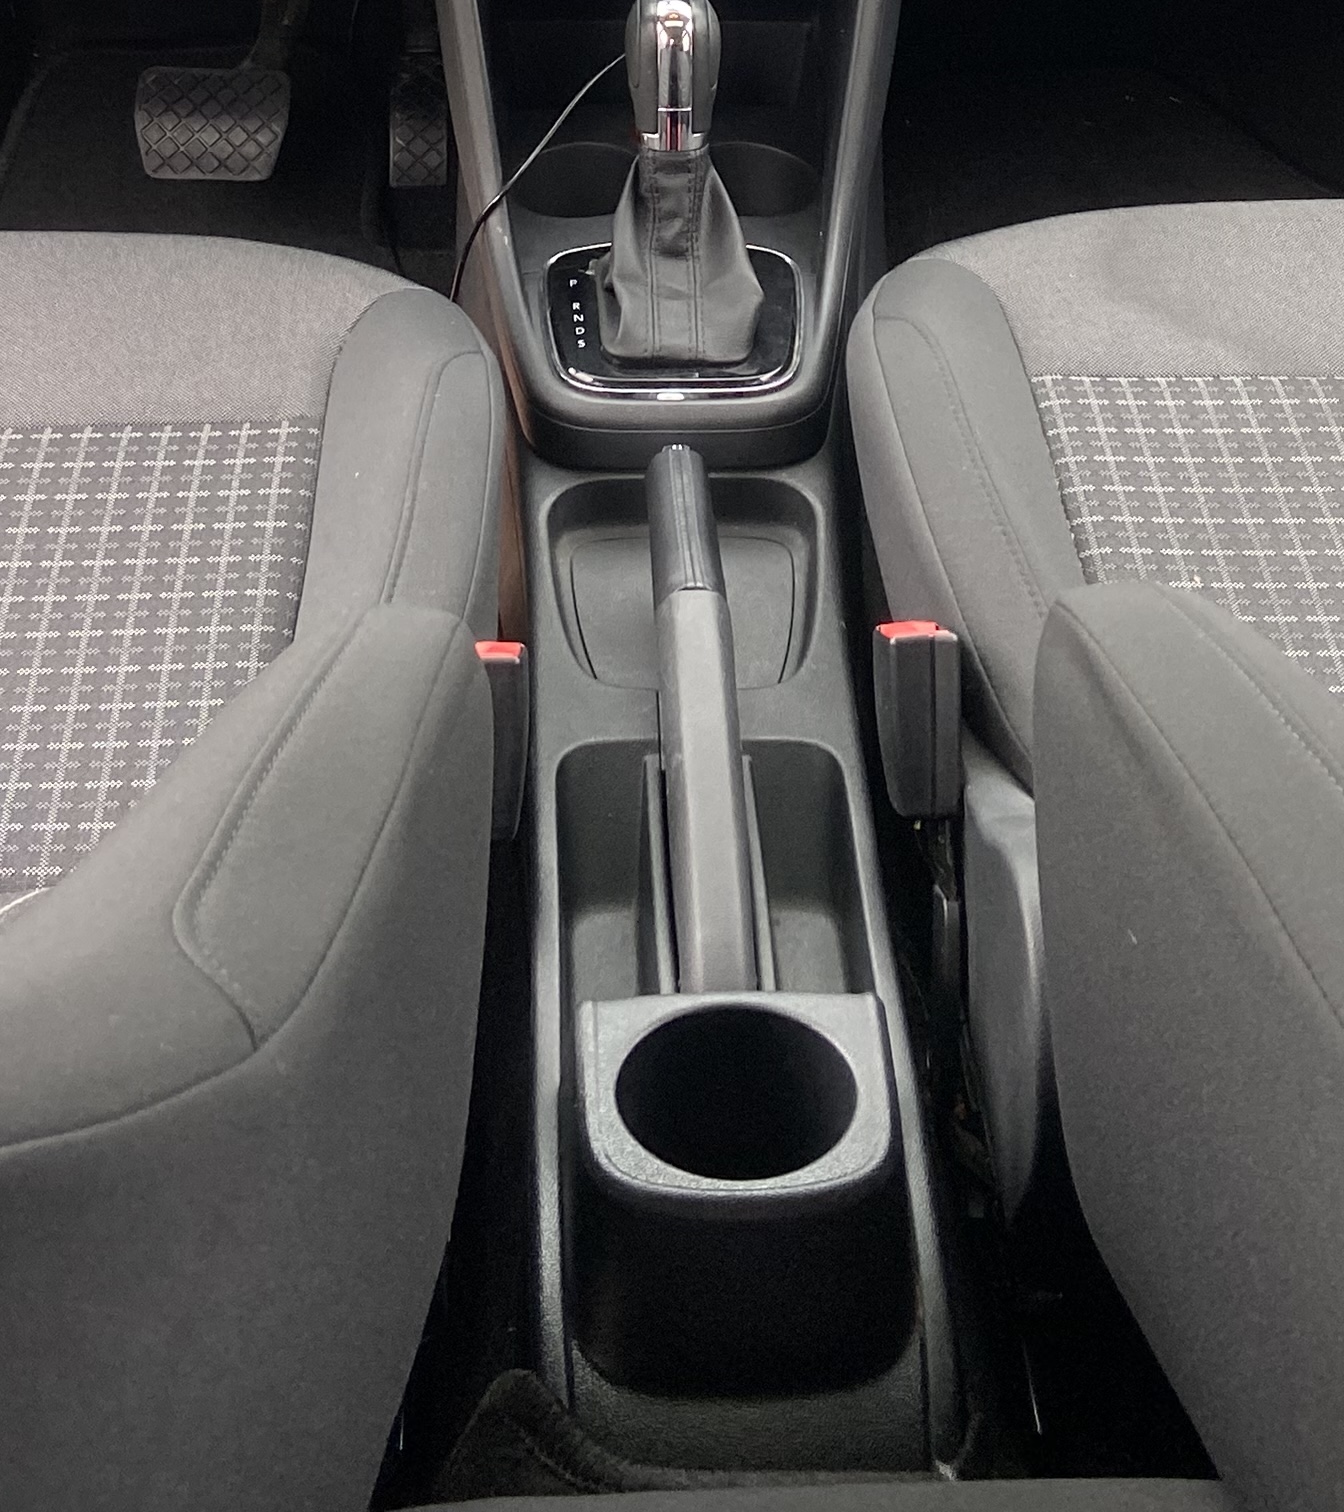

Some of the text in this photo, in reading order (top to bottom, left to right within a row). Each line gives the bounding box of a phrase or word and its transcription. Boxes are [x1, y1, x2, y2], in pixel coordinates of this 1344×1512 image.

[569, 279, 578, 288] P
[572, 302, 581, 310] R
[573, 314, 584, 323] N
[575, 326, 585, 336] D
[577, 339, 586, 348] S
